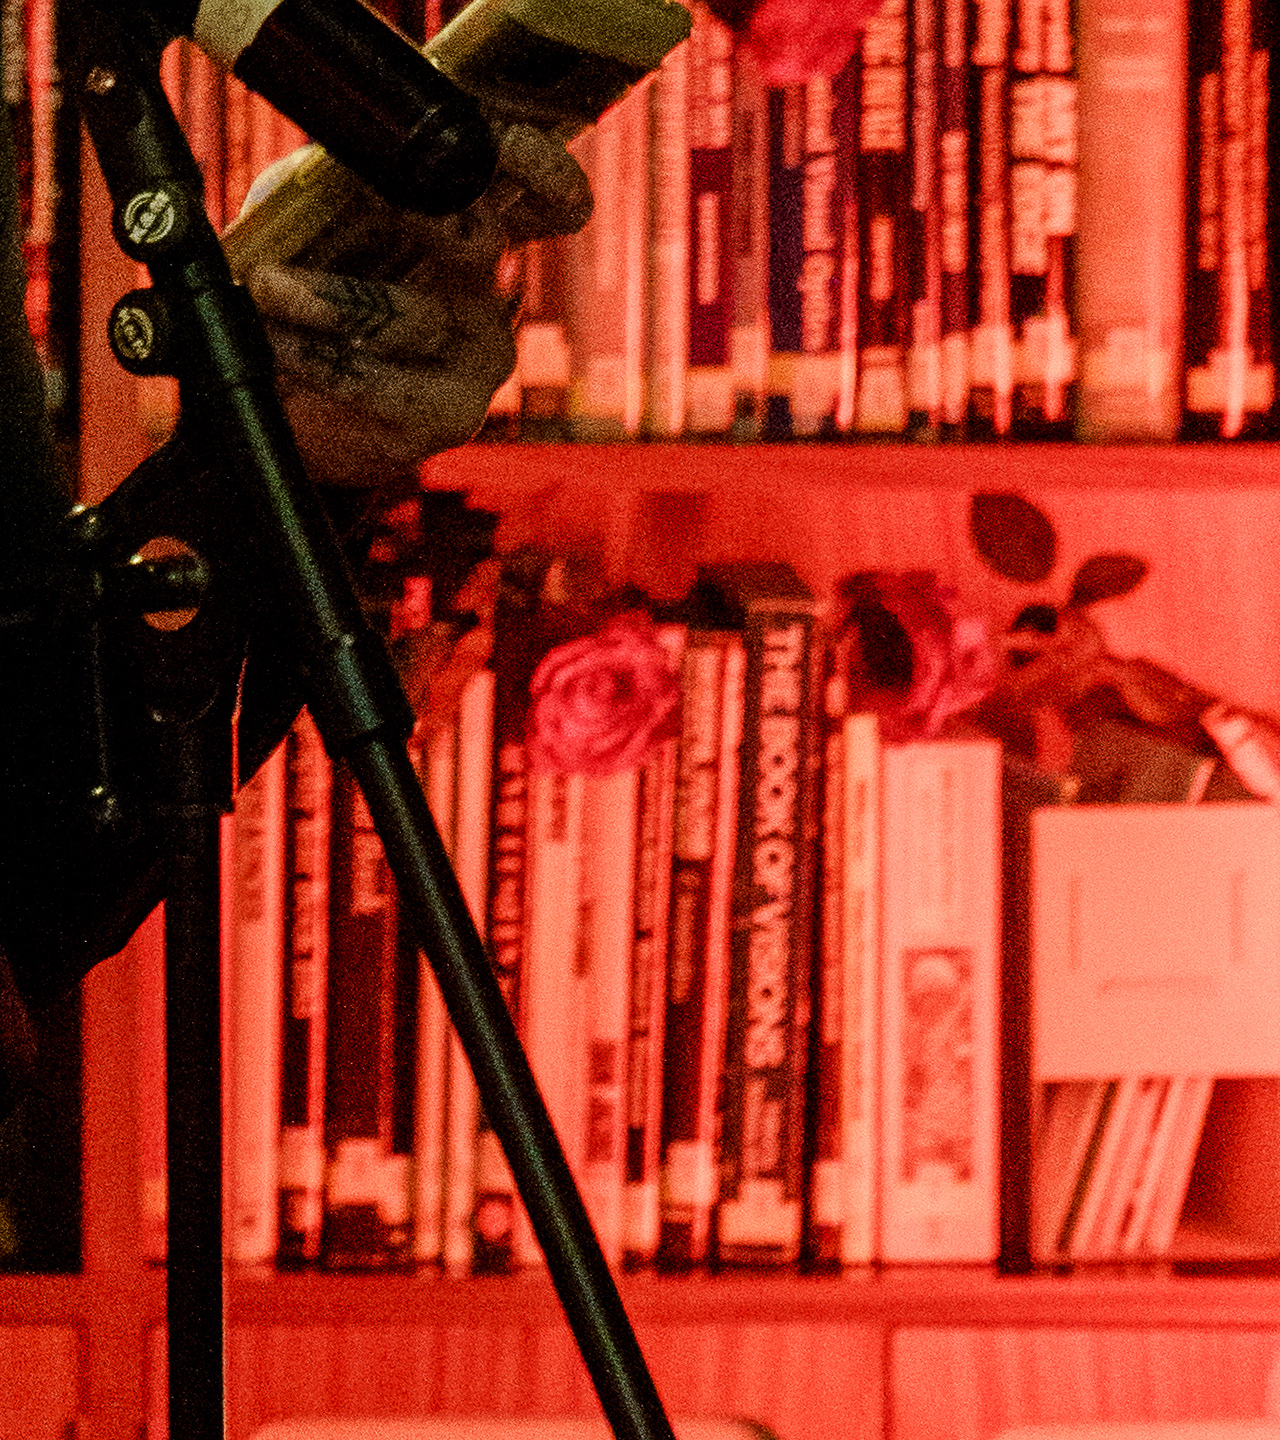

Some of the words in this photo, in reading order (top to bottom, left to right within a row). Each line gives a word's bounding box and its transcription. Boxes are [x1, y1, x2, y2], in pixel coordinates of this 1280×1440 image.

[761, 621, 804, 713] THE
[753, 716, 800, 830] BOOK
[751, 837, 796, 897] OF
[745, 899, 792, 1069] VISIONS
